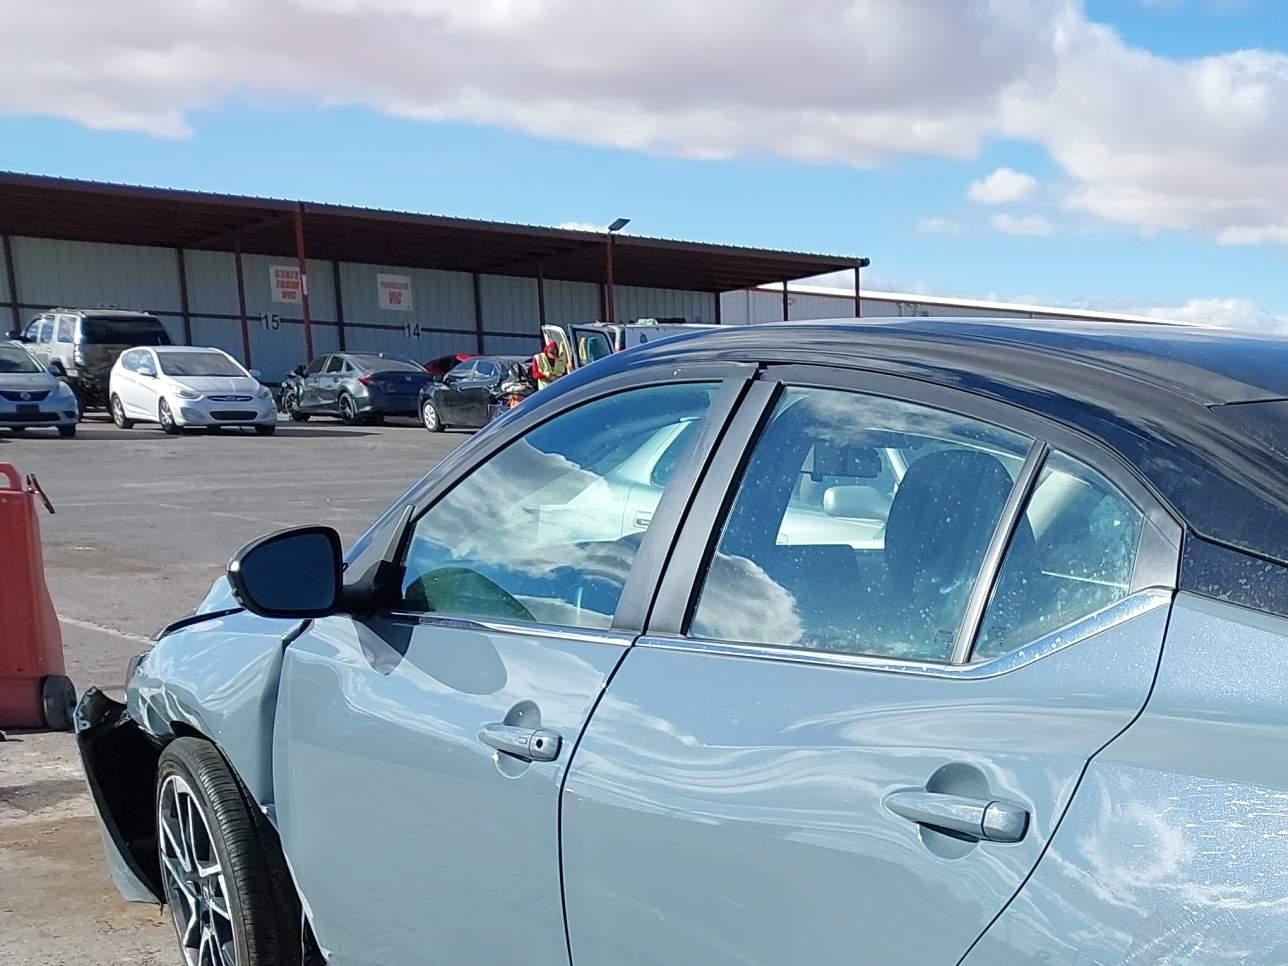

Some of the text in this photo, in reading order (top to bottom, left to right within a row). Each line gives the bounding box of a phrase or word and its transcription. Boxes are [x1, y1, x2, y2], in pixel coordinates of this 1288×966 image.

[388, 291, 402, 304] VIC
[261, 314, 280, 330] 15
[404, 324, 421, 338] 14
